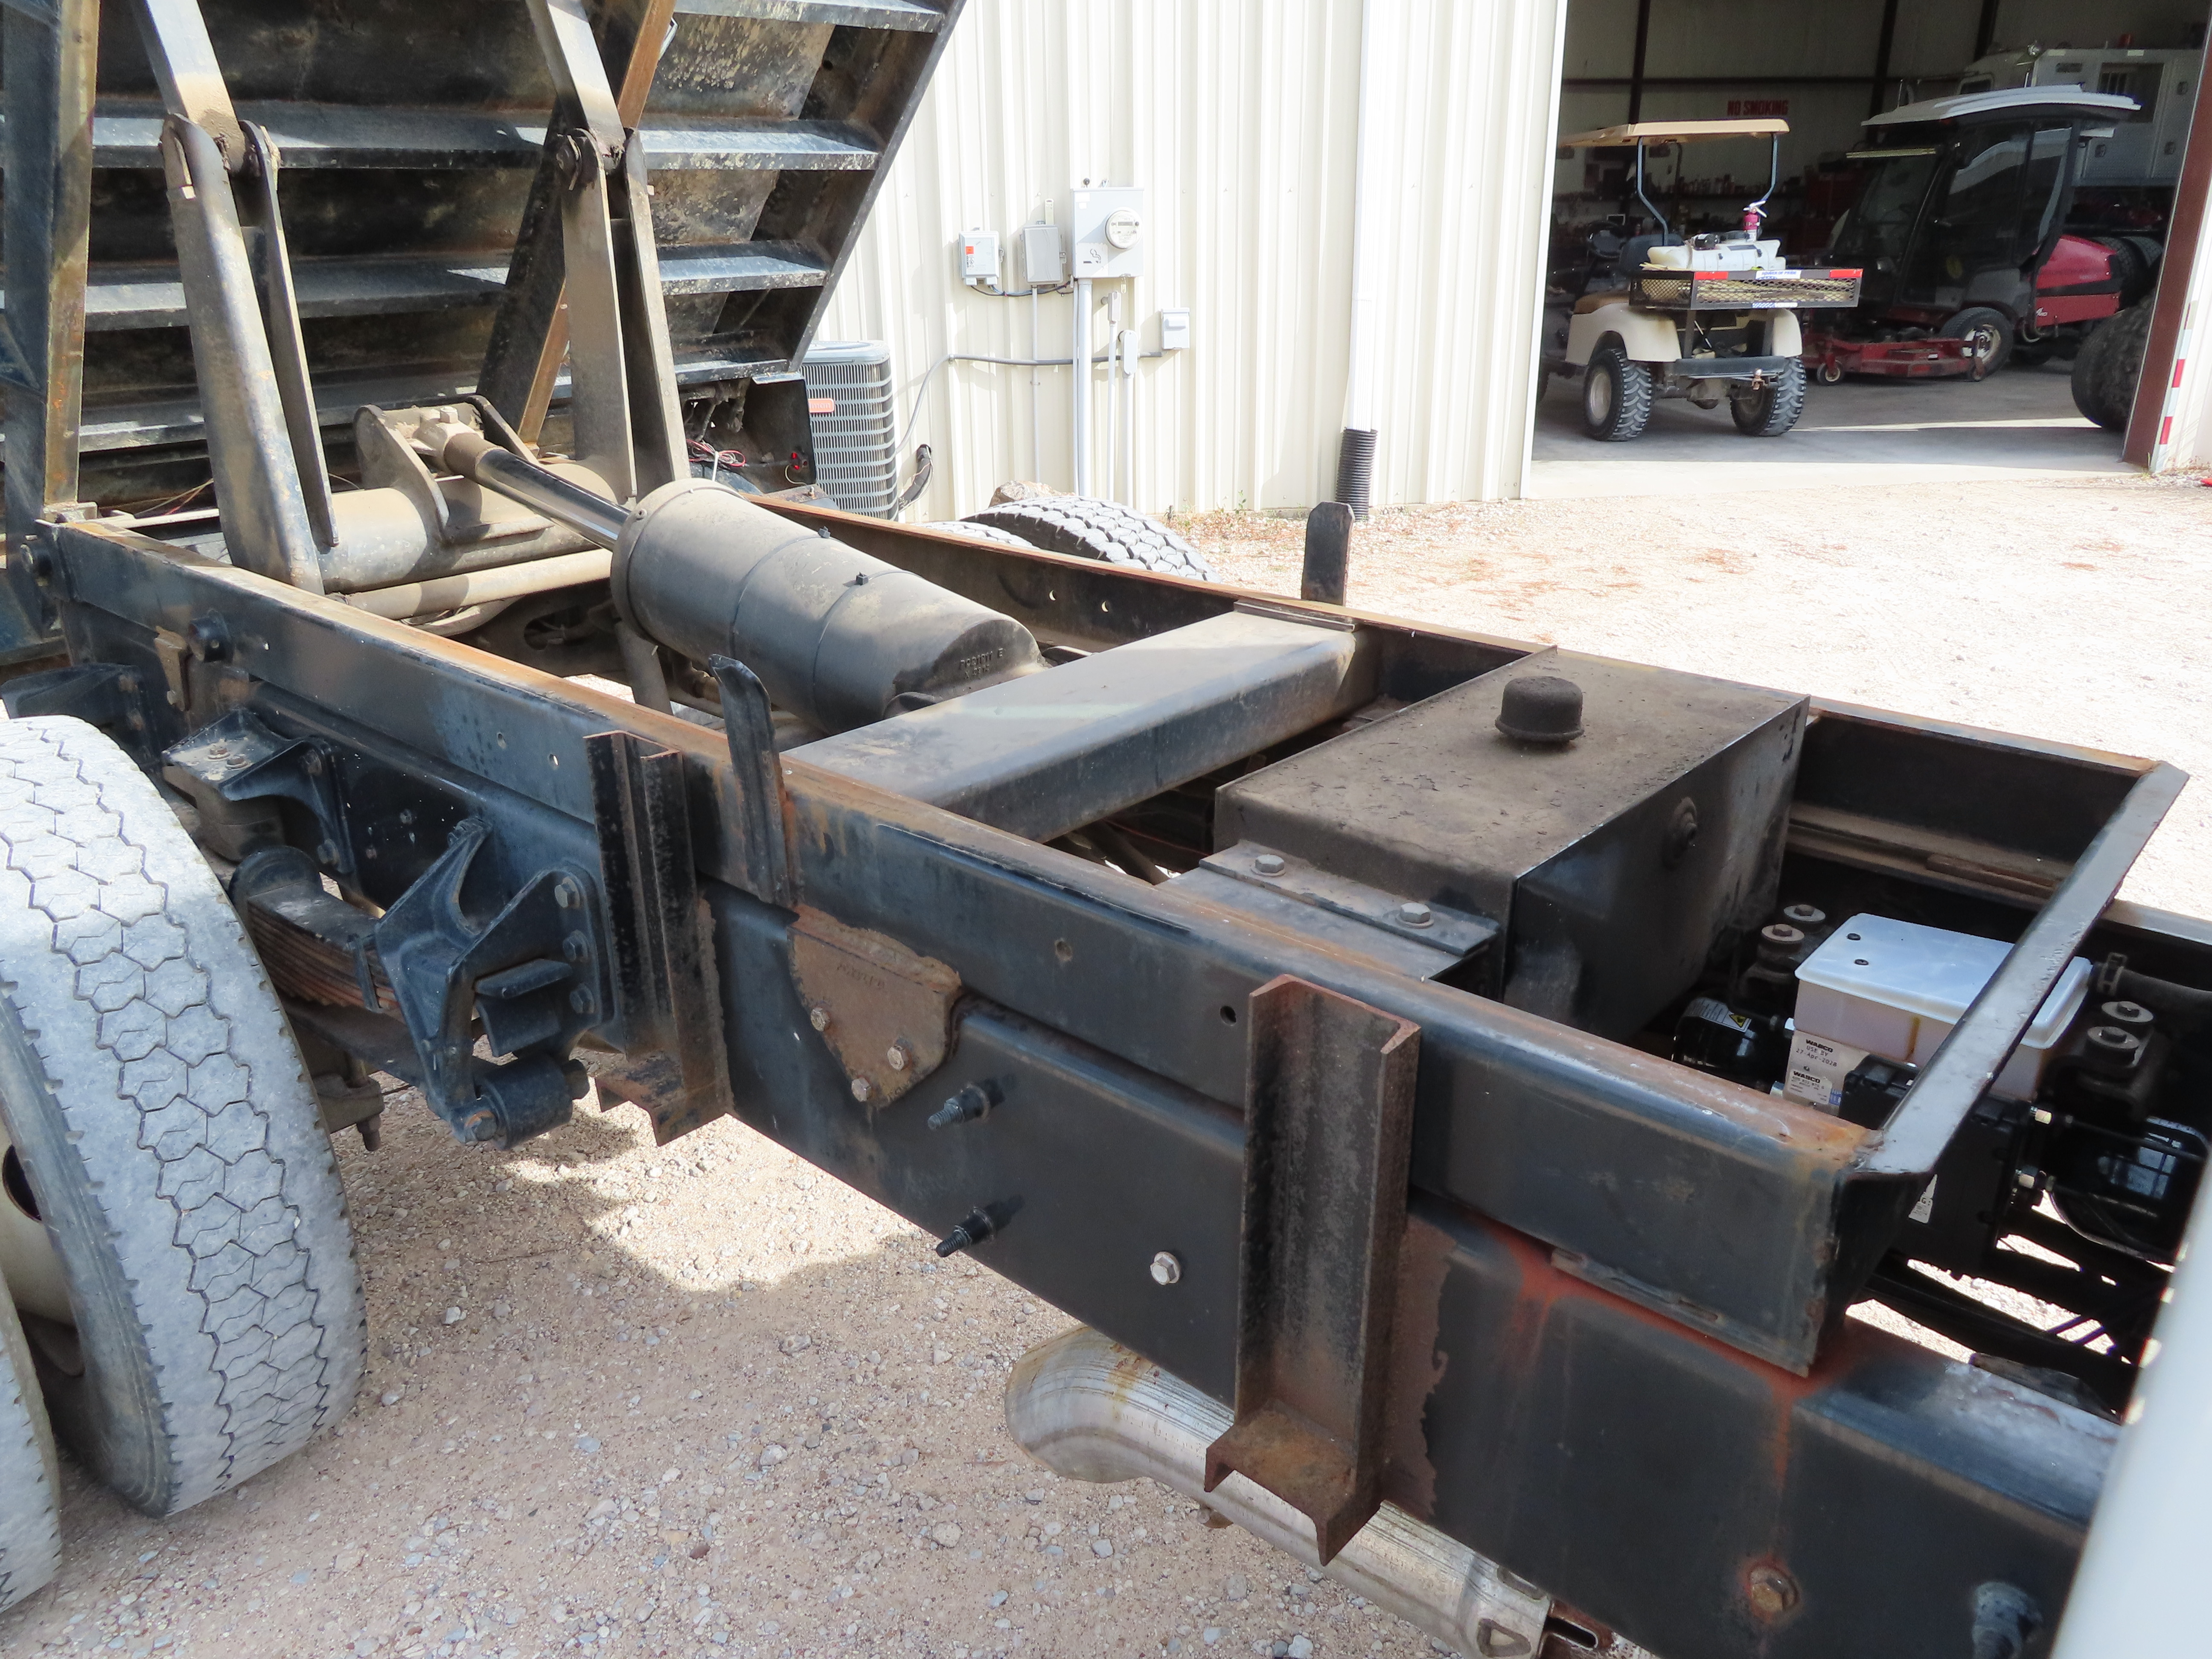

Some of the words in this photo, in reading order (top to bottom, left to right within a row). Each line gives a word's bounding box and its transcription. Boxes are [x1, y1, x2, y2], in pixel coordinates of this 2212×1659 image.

[1727, 100, 1741, 116] NO
[1743, 100, 1789, 115] SMOKING
[1806, 1039, 1834, 1053] WABCO
[1793, 1071, 1821, 1083] WABCO
